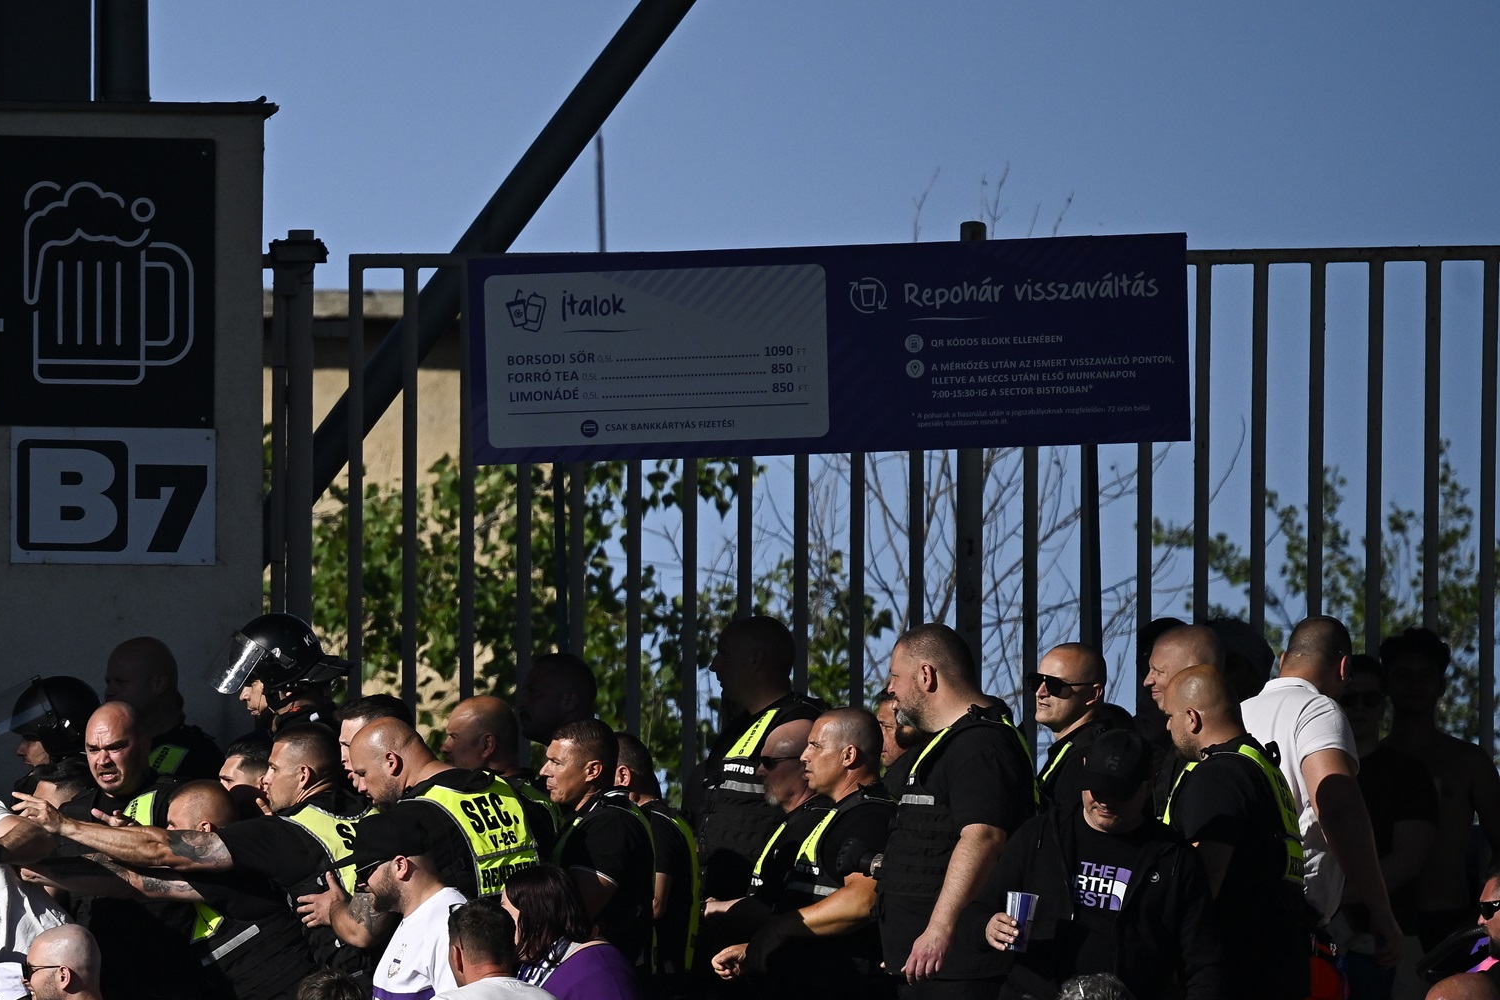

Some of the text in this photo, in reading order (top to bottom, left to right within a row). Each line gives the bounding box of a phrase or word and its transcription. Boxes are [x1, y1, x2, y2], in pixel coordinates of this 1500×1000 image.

[904, 271, 1159, 309] Repohár visszaváltás
[931, 333, 1063, 348] QR KÓDOS BLOKK ELLENÉBEN
[507, 353, 566, 367] BORSODI
[569, 349, 596, 364] SÖR
[764, 345, 794, 358] 1090
[796, 348, 807, 356] FT
[931, 355, 1175, 371] A MÉRKŐZÉS UTÁN AZ ISMERT VISSZAVÁLTÓ PONTON,
[508, 368, 551, 384] FORRÓ
[554, 369, 579, 382] TEA
[771, 363, 793, 375] 850
[797, 365, 808, 373] FT
[931, 376, 967, 385] ILLETVE
[978, 374, 1009, 383] MECCS
[1011, 372, 1040, 382] UTÁNI
[1042, 370, 1064, 381] ELSŐ
[1066, 369, 1136, 380] MUNKANAPON
[509, 387, 580, 402] LIMONÁDÉ
[772, 382, 795, 394] 850
[798, 384, 809, 393] FT
[932, 389, 988, 399] 7:00-15:30-IG
[990, 389, 998, 397] A
[999, 387, 1034, 396] SECTOR
[1107, 405, 1117, 413] 72
[605, 423, 628, 433] CSAK
[630, 420, 697, 432] BANKKÁRTYÁS
[18, 440, 208, 553] B7
[460, 792, 520, 834] SEC.
[489, 831, 518, 849] V-26
[1081, 861, 1116, 880] THE
